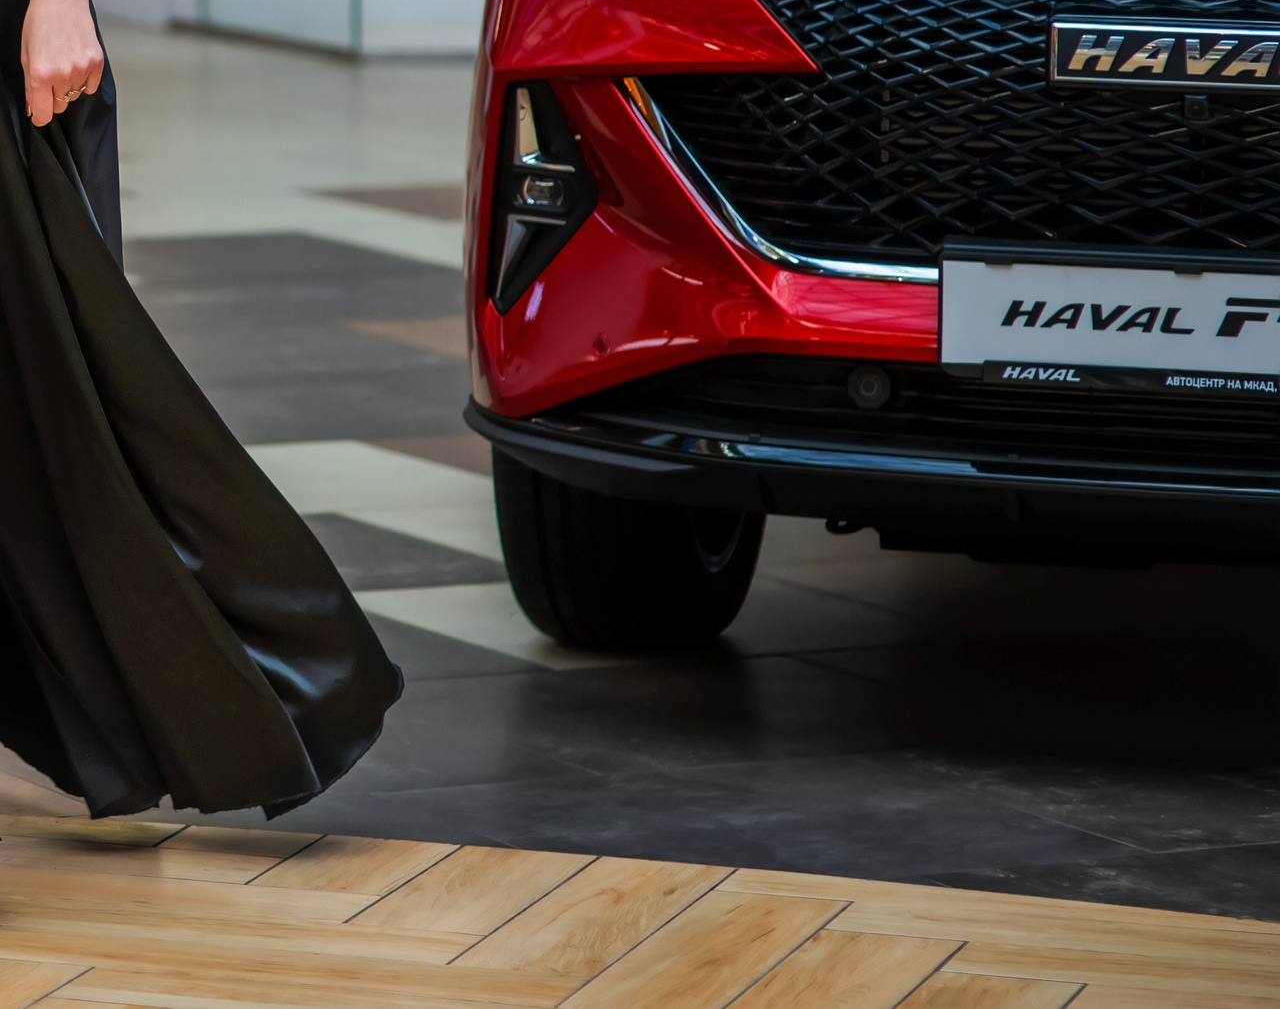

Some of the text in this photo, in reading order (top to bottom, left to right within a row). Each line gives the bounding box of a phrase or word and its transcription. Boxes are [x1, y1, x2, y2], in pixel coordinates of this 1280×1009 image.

[1067, 34, 1280, 78] HAVA
[1000, 296, 1280, 338] HAVAL F
[1002, 365, 1081, 383] HAVAL
[1165, 376, 1278, 393] АВТОЦЕНТР НА МКАД,
